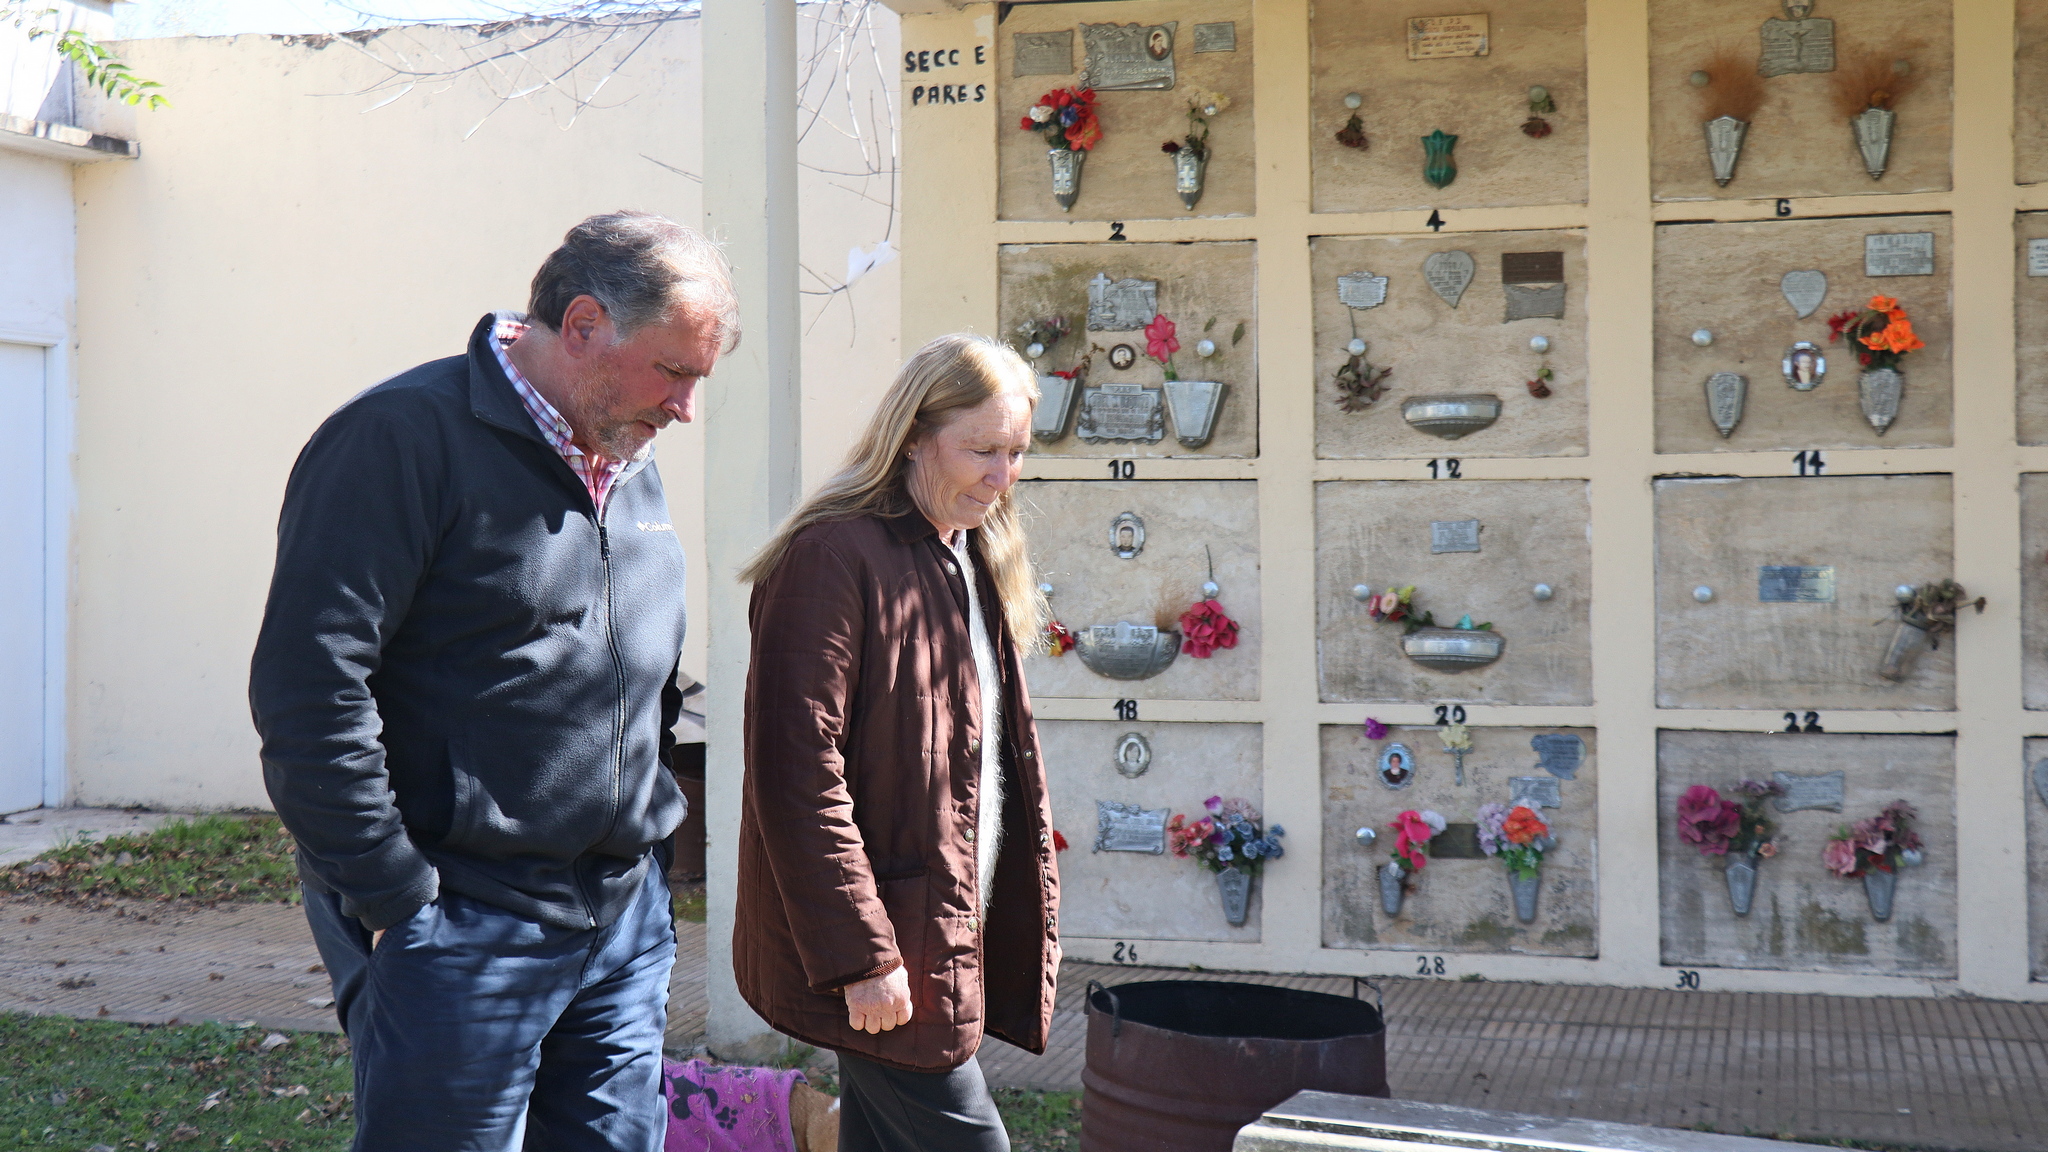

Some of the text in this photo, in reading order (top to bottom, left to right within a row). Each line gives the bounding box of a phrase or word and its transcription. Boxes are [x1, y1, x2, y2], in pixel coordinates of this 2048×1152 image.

[904, 45, 986, 73] SECC E
[912, 84, 986, 106] PARES
[1108, 221, 1127, 241] 2
[1426, 209, 1446, 232] 4
[1107, 459, 1137, 480] 10
[1426, 458, 1462, 479] 12
[1792, 450, 1825, 476] 14
[1113, 698, 1138, 721] 18
[1434, 705, 1466, 725] 20
[1783, 711, 1824, 733] 22
[1112, 941, 1138, 963] 26
[1416, 956, 1447, 976] 28
[1674, 970, 1701, 990] 30
